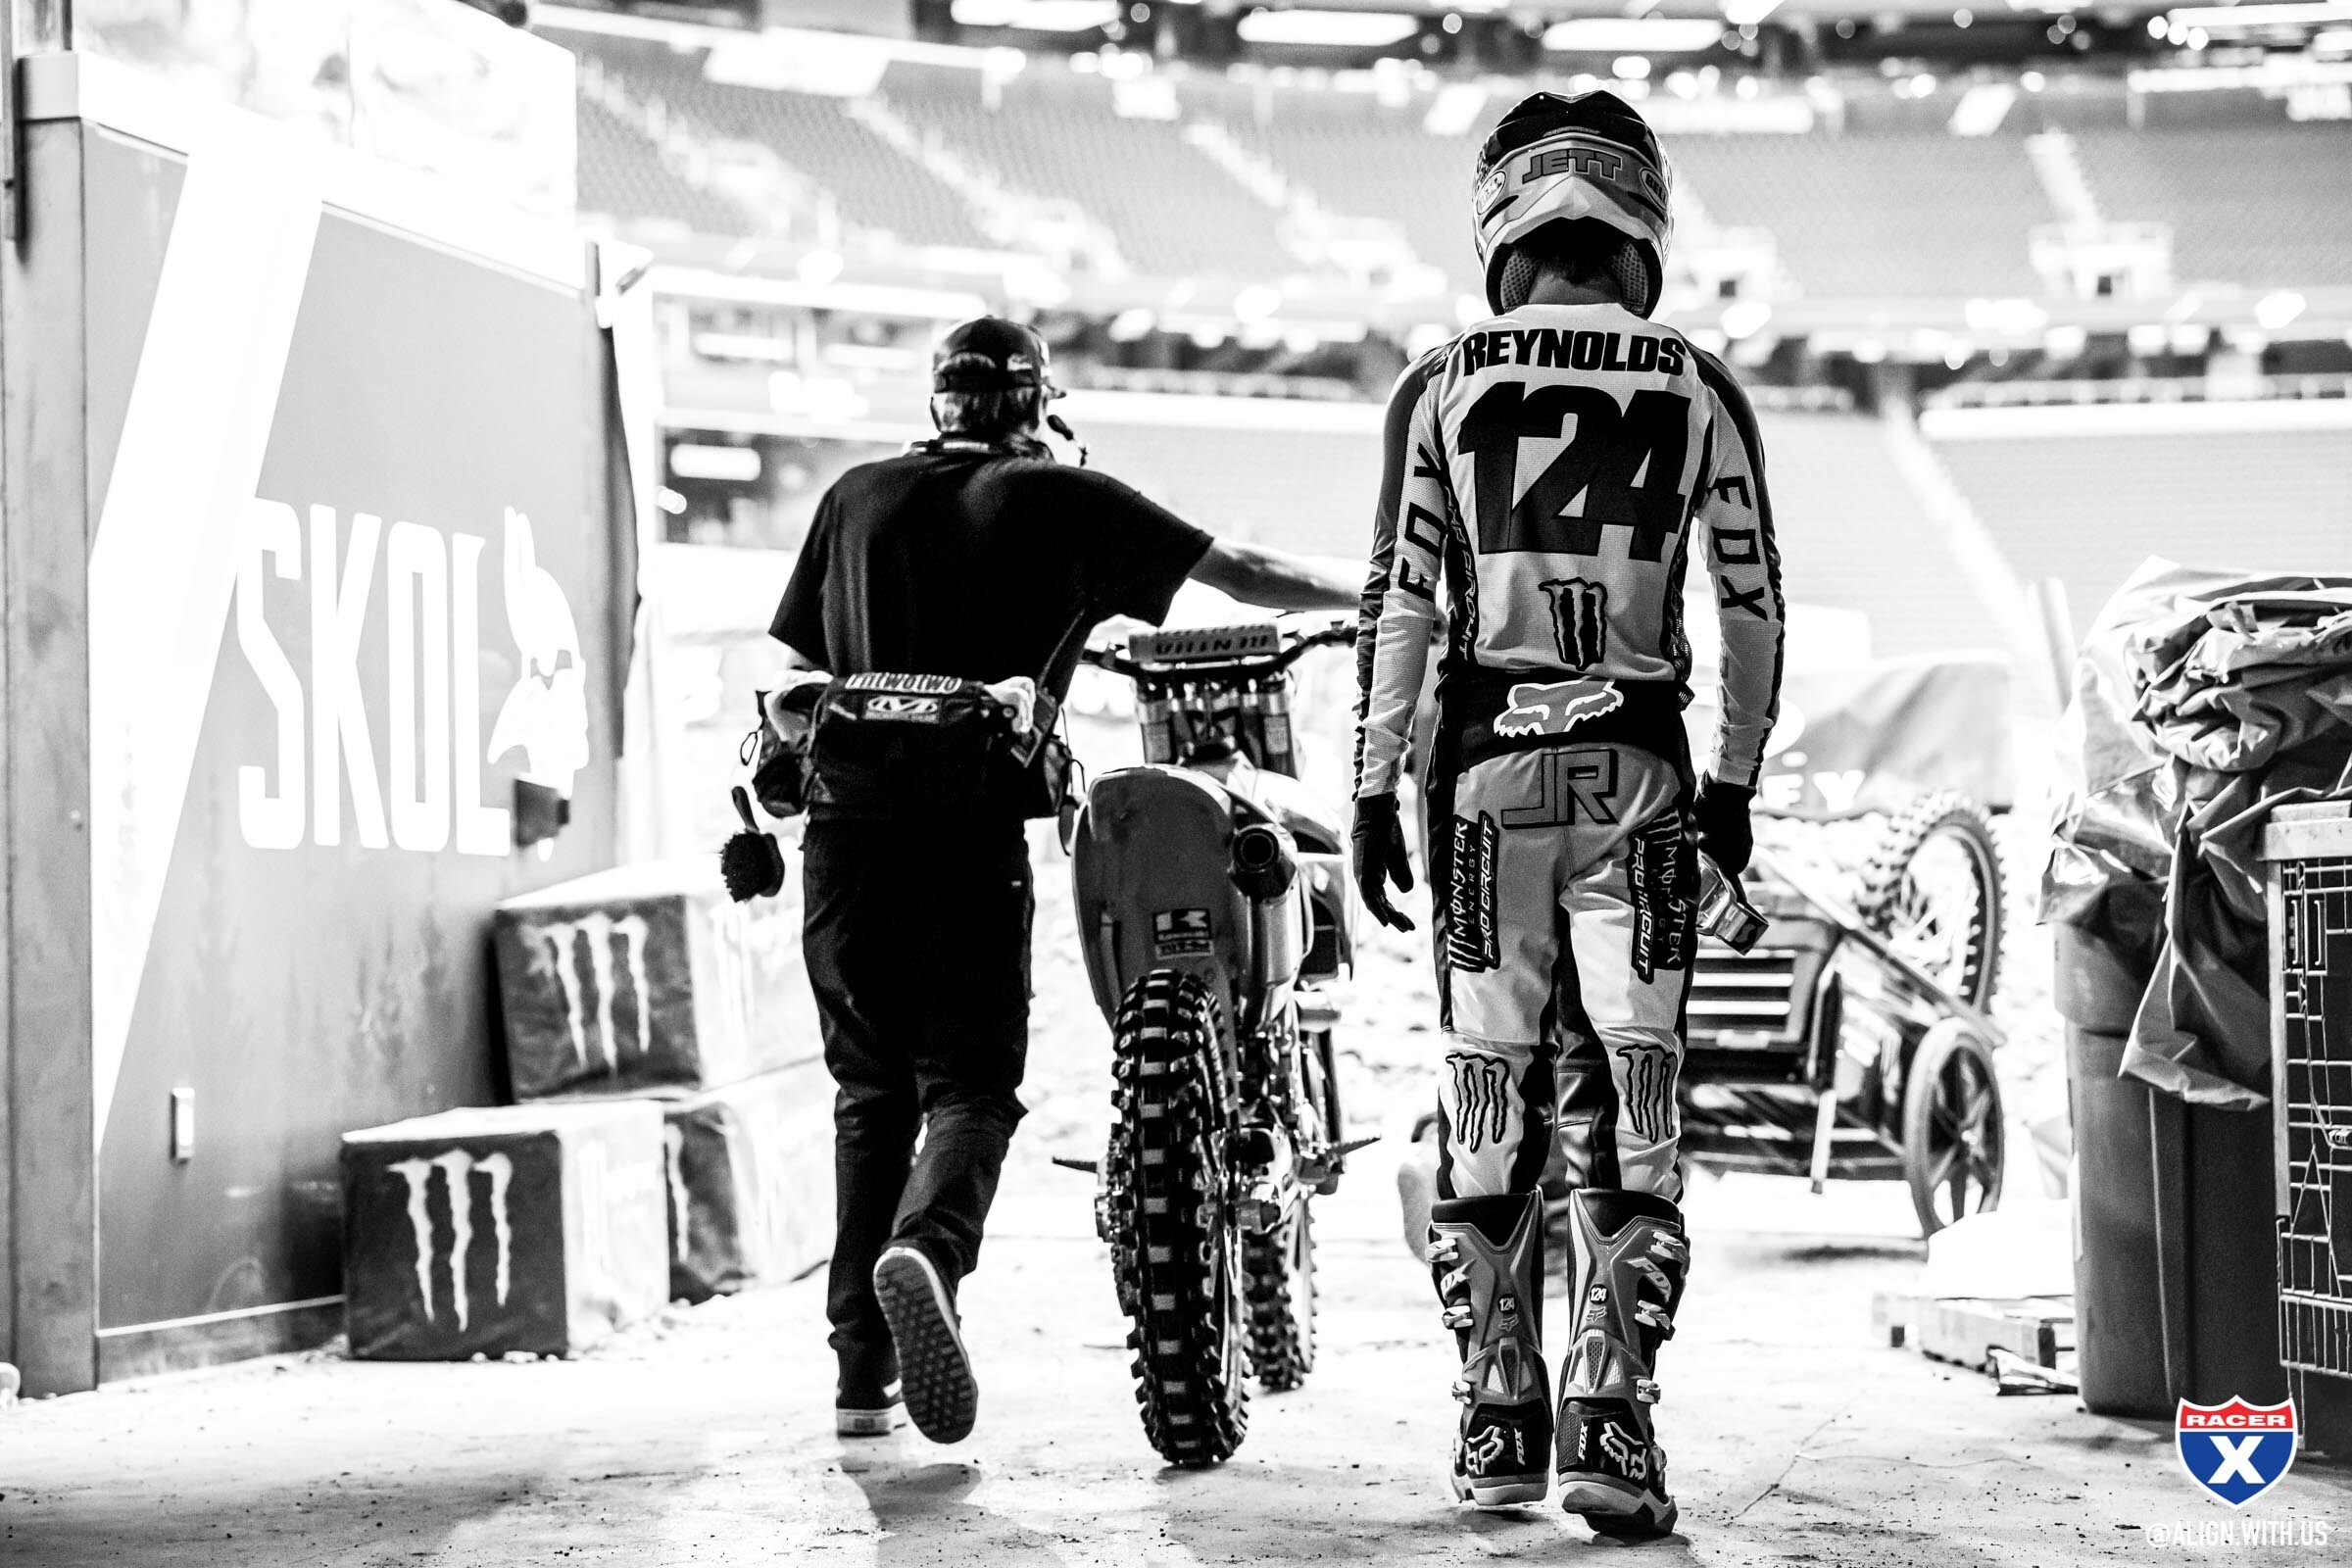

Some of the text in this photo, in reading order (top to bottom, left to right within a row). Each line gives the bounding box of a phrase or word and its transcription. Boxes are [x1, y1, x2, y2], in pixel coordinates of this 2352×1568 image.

[1522, 148, 1622, 184] JETT
[1463, 328, 1687, 376] REYNOLDS
[1457, 381, 1691, 563] 124
[1711, 475, 1768, 621] FOX
[236, 497, 510, 858] SKOL
[1501, 748, 1618, 830] JR
[1450, 822, 1468, 937] MONSTER
[1632, 837, 1645, 888] PRO
[1479, 819, 1494, 960] PRO CIRCUIT
[1498, 1297, 1516, 1311] 124
[1590, 1287, 1608, 1301] 124
[1514, 1427, 1526, 1466] FOX
[1577, 1422, 1589, 1461] FOX
